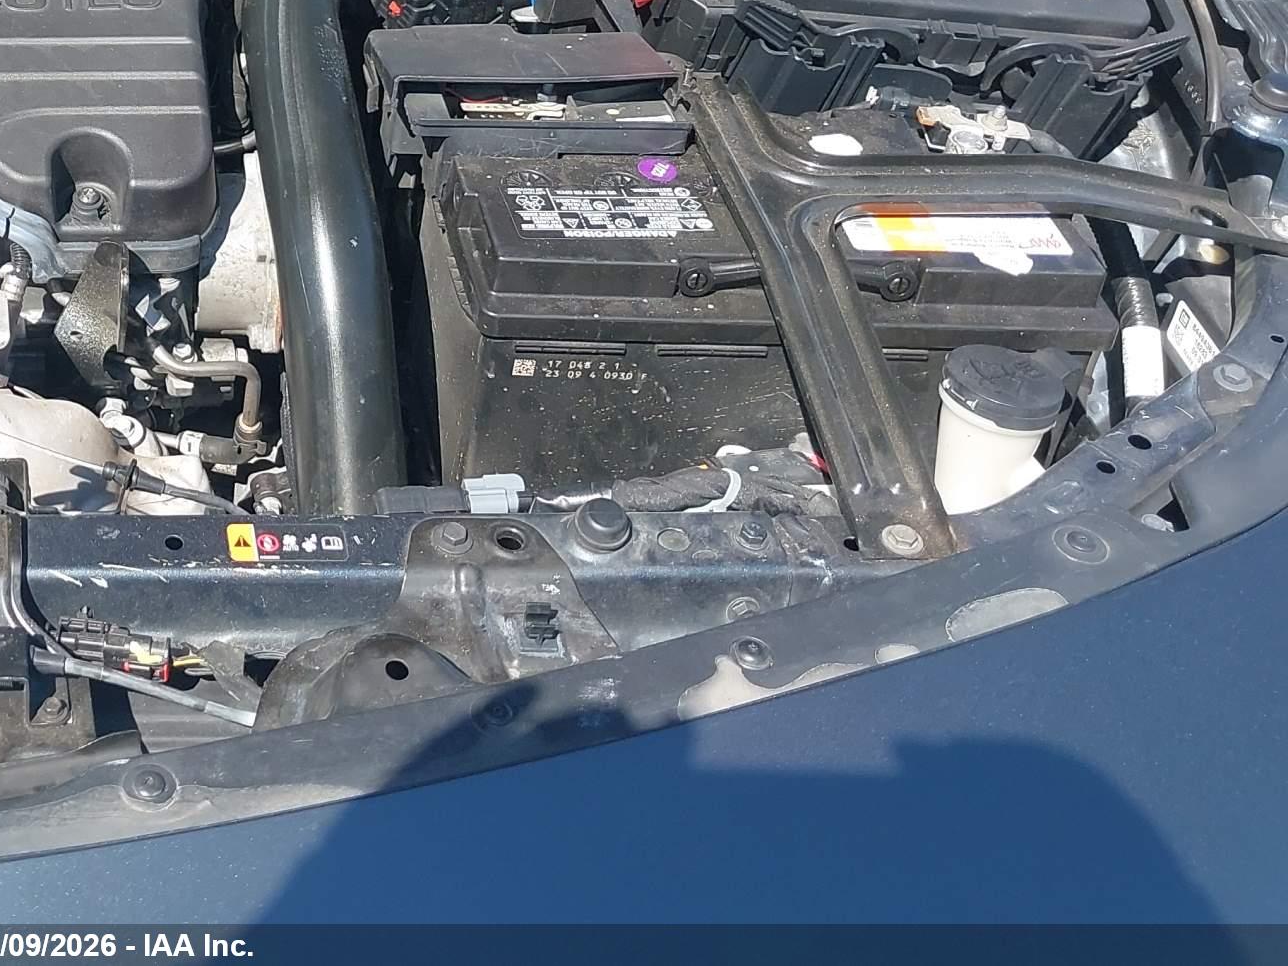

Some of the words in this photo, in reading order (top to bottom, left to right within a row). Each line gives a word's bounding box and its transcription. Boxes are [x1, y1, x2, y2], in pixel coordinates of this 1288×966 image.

[548, 360, 562, 368] 17
[598, 362, 607, 370] 2
[545, 369, 560, 378] 23
[567, 370, 582, 379] 09
[589, 371, 596, 379] 4
